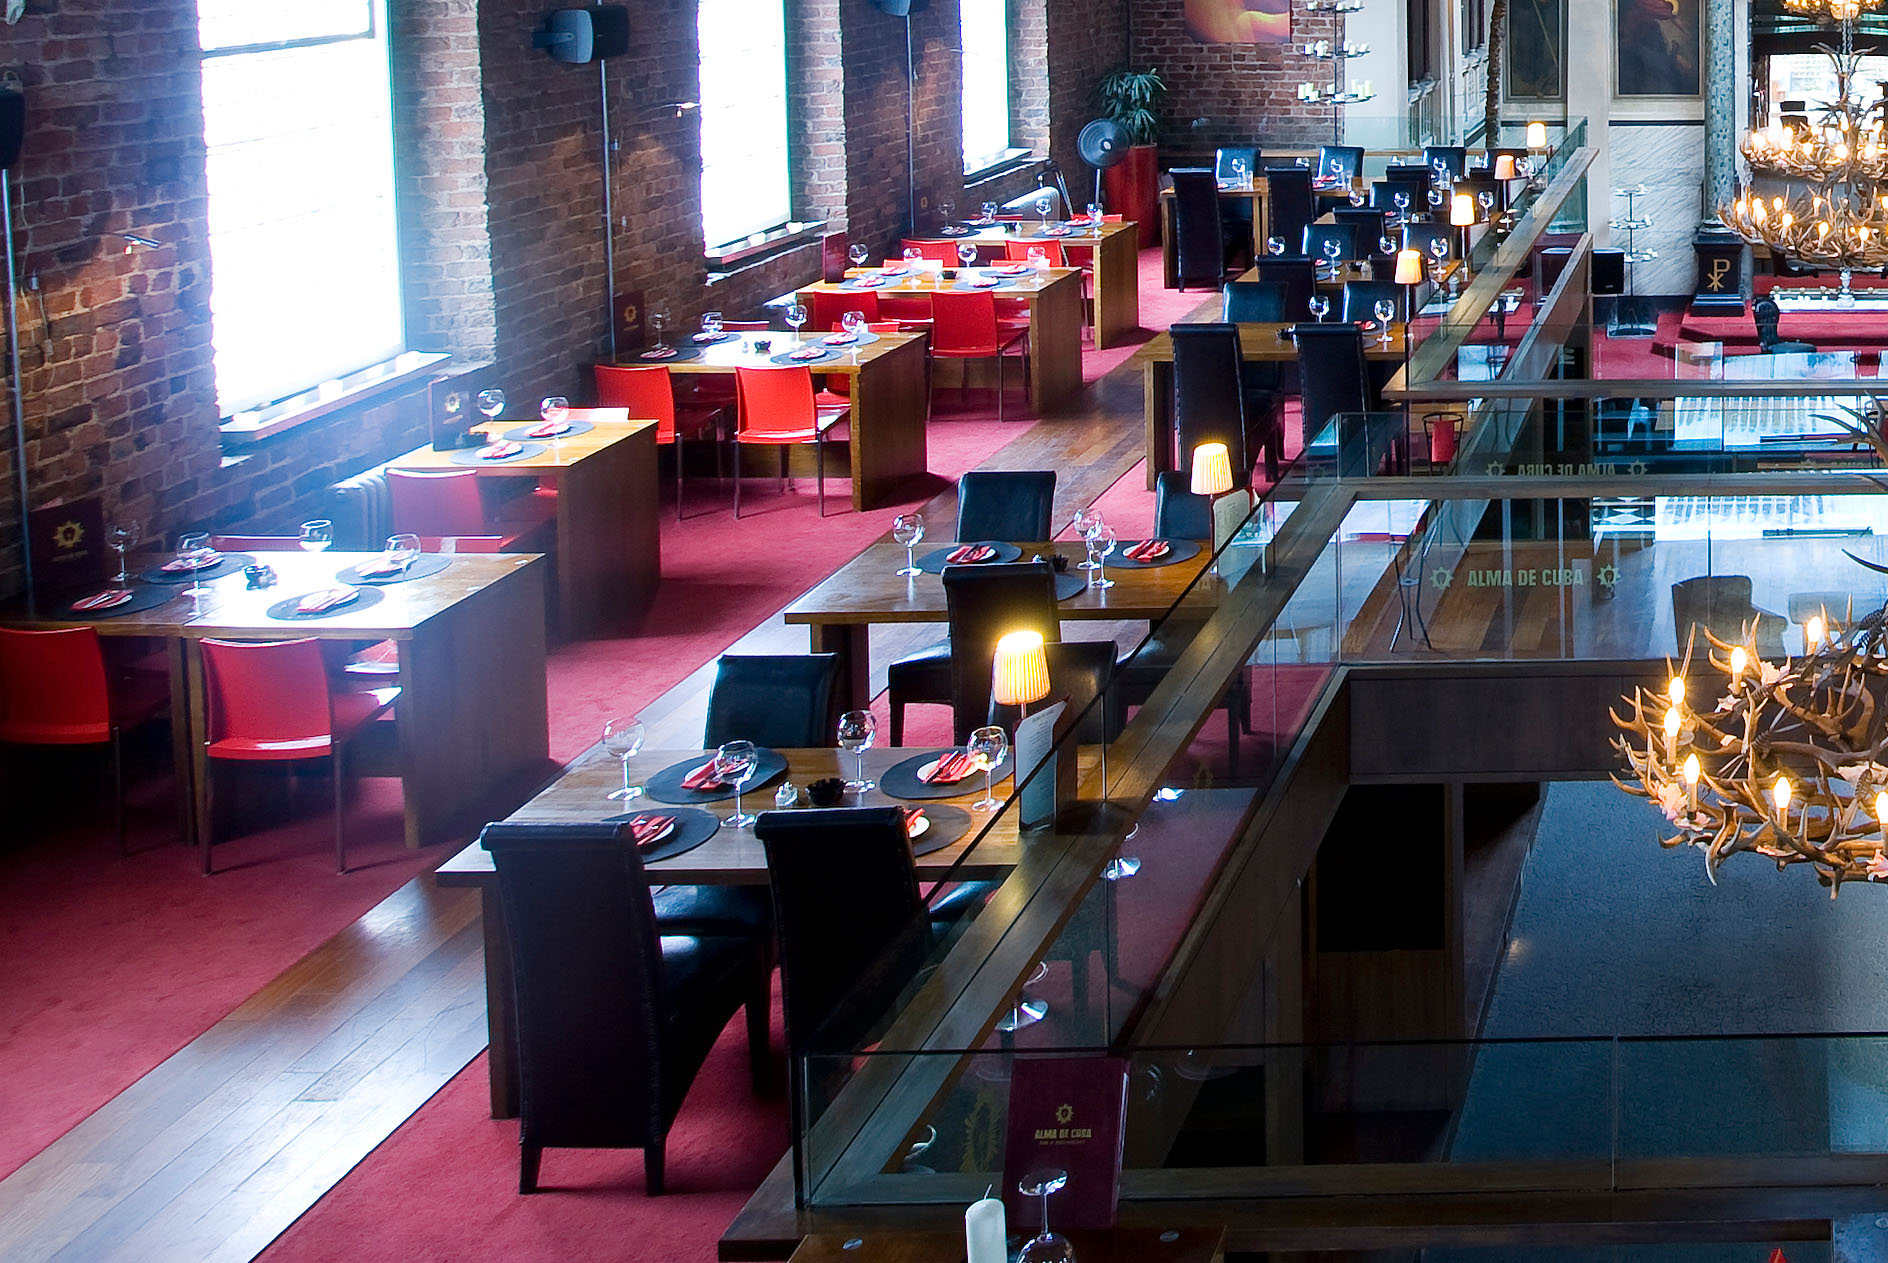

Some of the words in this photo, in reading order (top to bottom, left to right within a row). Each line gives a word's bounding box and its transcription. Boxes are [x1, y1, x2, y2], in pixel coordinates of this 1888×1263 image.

[1467, 569, 1512, 586] ALMA
[1518, 569, 1536, 586] DE
[1542, 568, 1583, 586] CUBA
